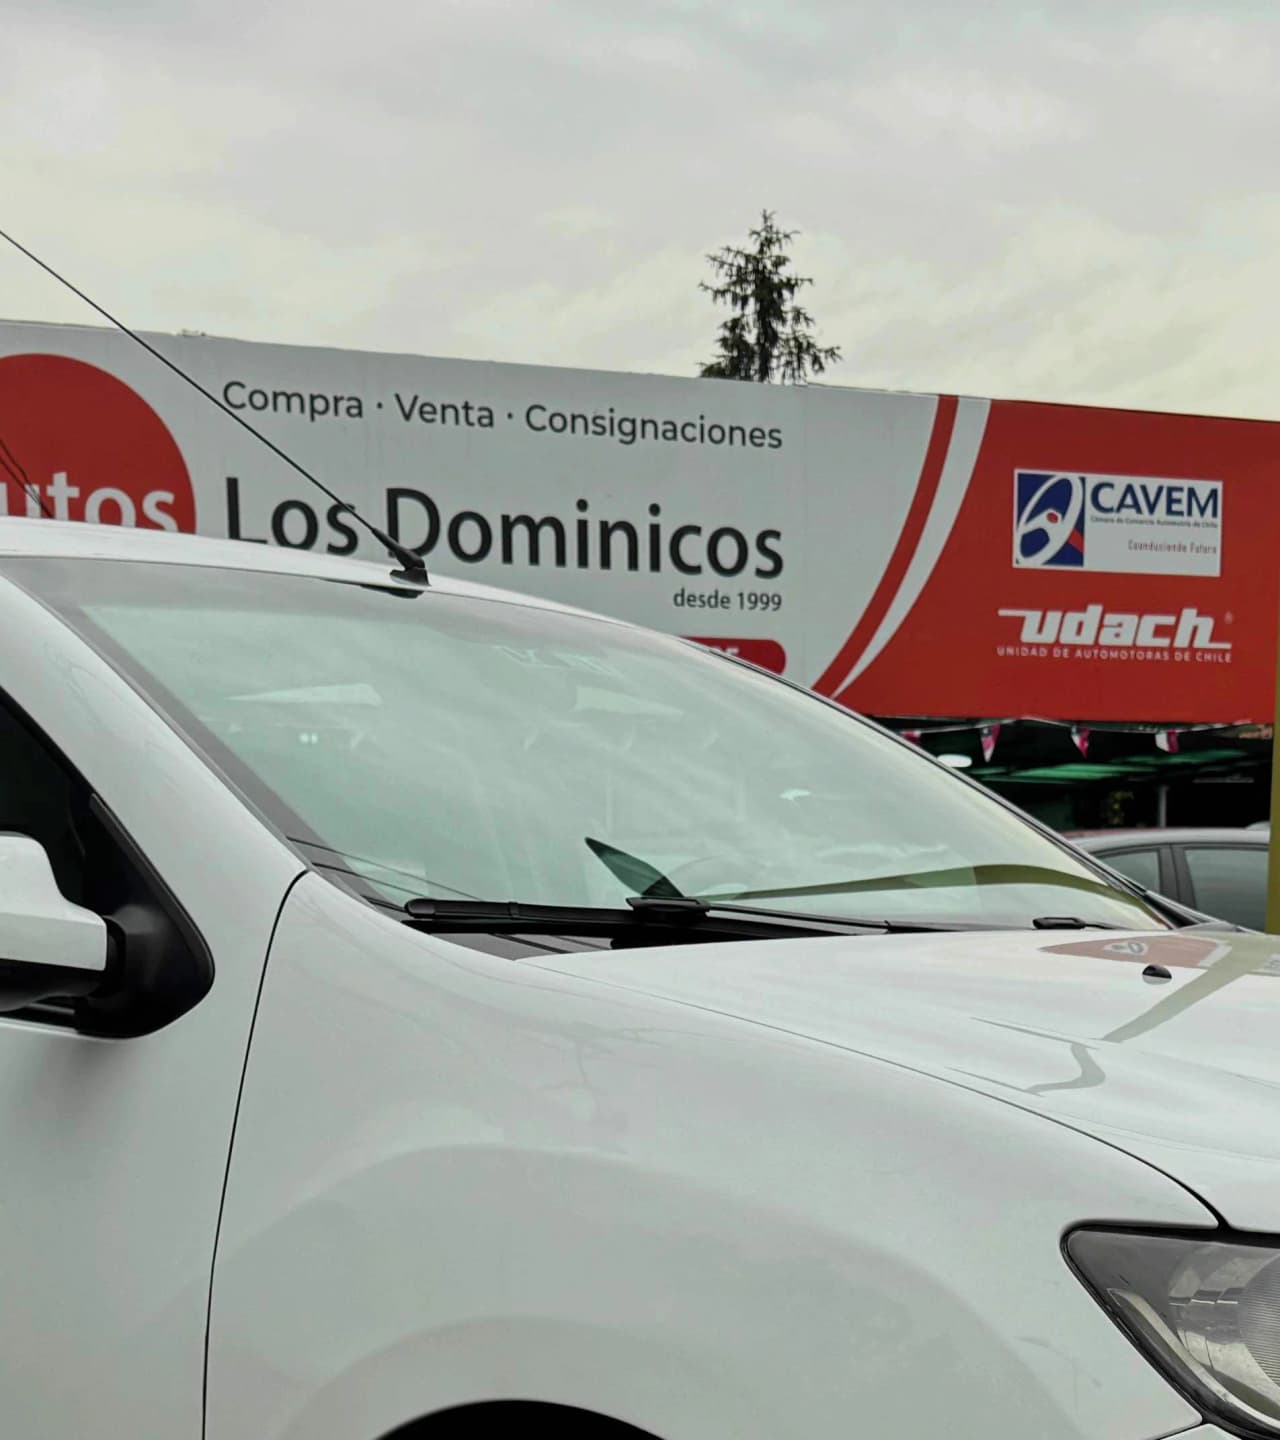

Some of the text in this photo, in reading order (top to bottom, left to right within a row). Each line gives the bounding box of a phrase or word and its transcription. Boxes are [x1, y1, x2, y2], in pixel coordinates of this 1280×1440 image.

[222, 381, 783, 449] Compra Venta Consignaciones
[1090, 481, 1219, 519] CAVEM
[225, 475, 785, 580] Los Dominicos
[673, 588, 782, 611] desde 1999
[997, 646, 1232, 664] UNIDAD DE AUTOMOTORAS DE CHILE
